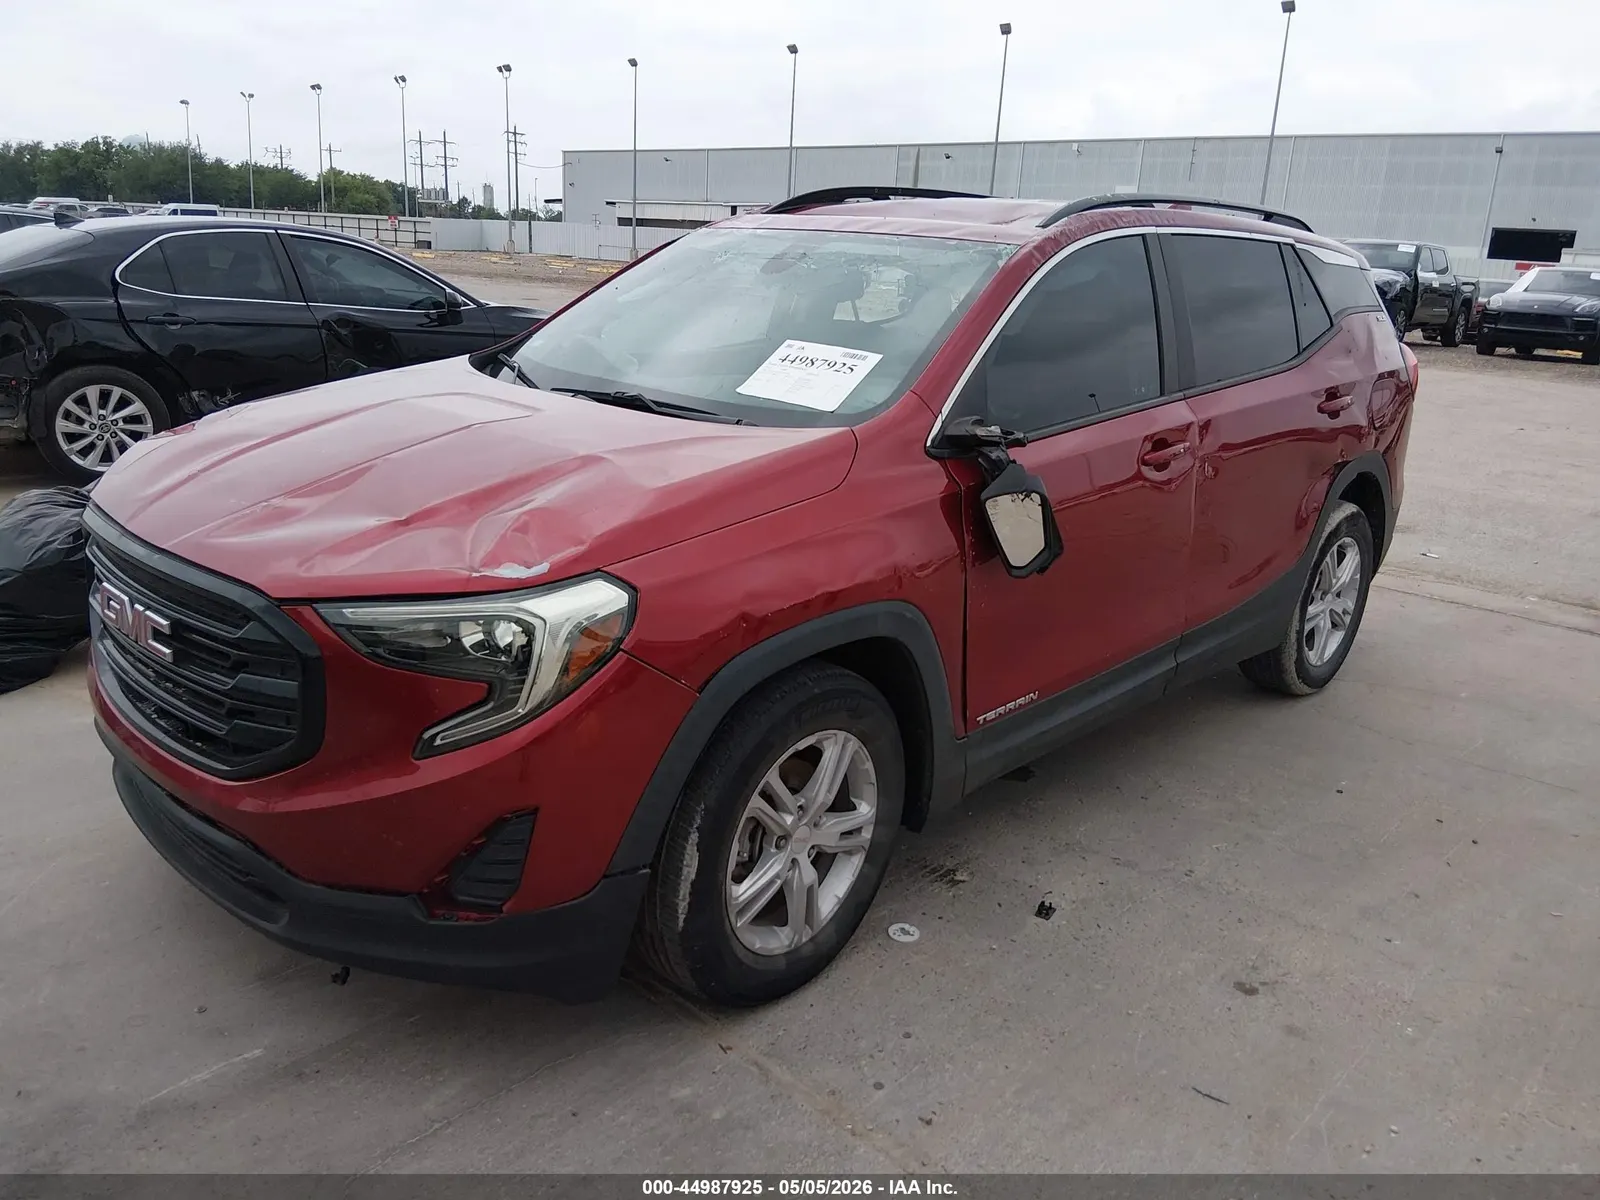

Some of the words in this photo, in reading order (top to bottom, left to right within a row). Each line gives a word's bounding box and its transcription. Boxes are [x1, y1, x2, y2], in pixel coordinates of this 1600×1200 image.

[778, 353, 859, 375] 44987925
[100, 582, 174, 662] GMC
[976, 691, 1039, 725] TERRAIN
